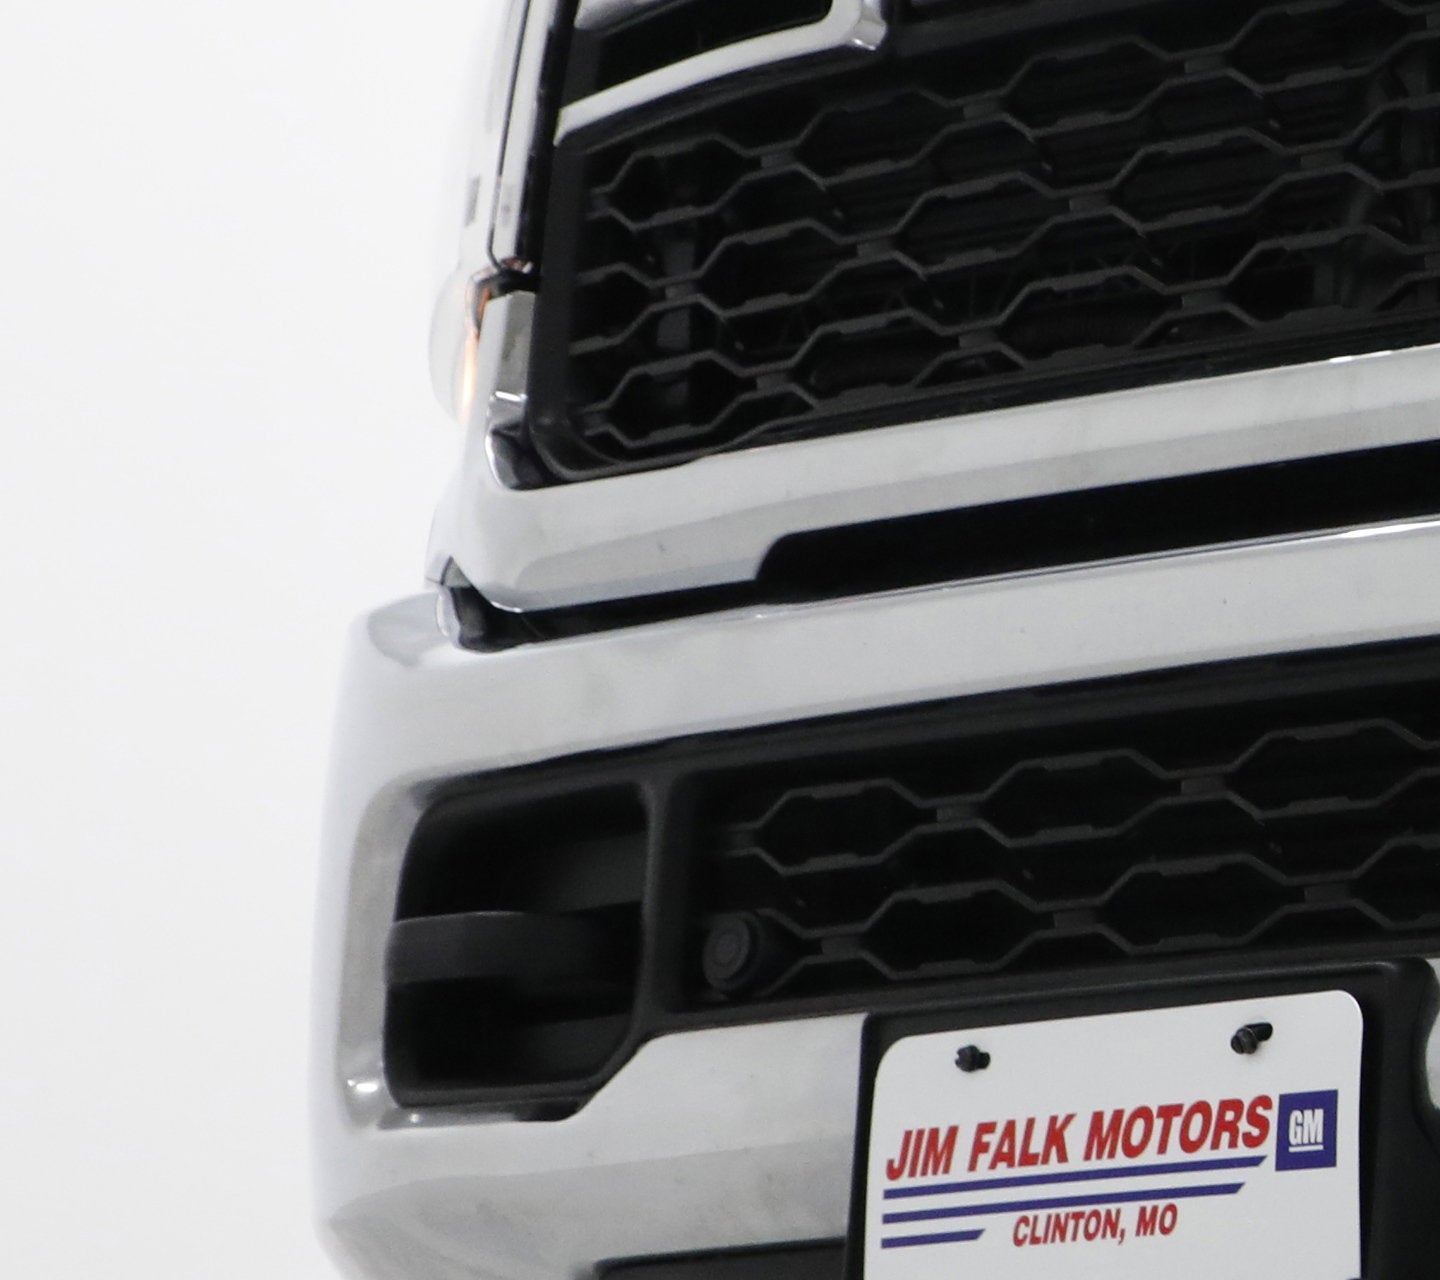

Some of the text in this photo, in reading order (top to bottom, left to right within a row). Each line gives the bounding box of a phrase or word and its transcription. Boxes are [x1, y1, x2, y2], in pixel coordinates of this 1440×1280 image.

[886, 1095, 1274, 1182] JIM FALK MOTORS
[1288, 1108, 1324, 1145] GM
[1013, 1203, 1178, 1247] CLINTON, MO
